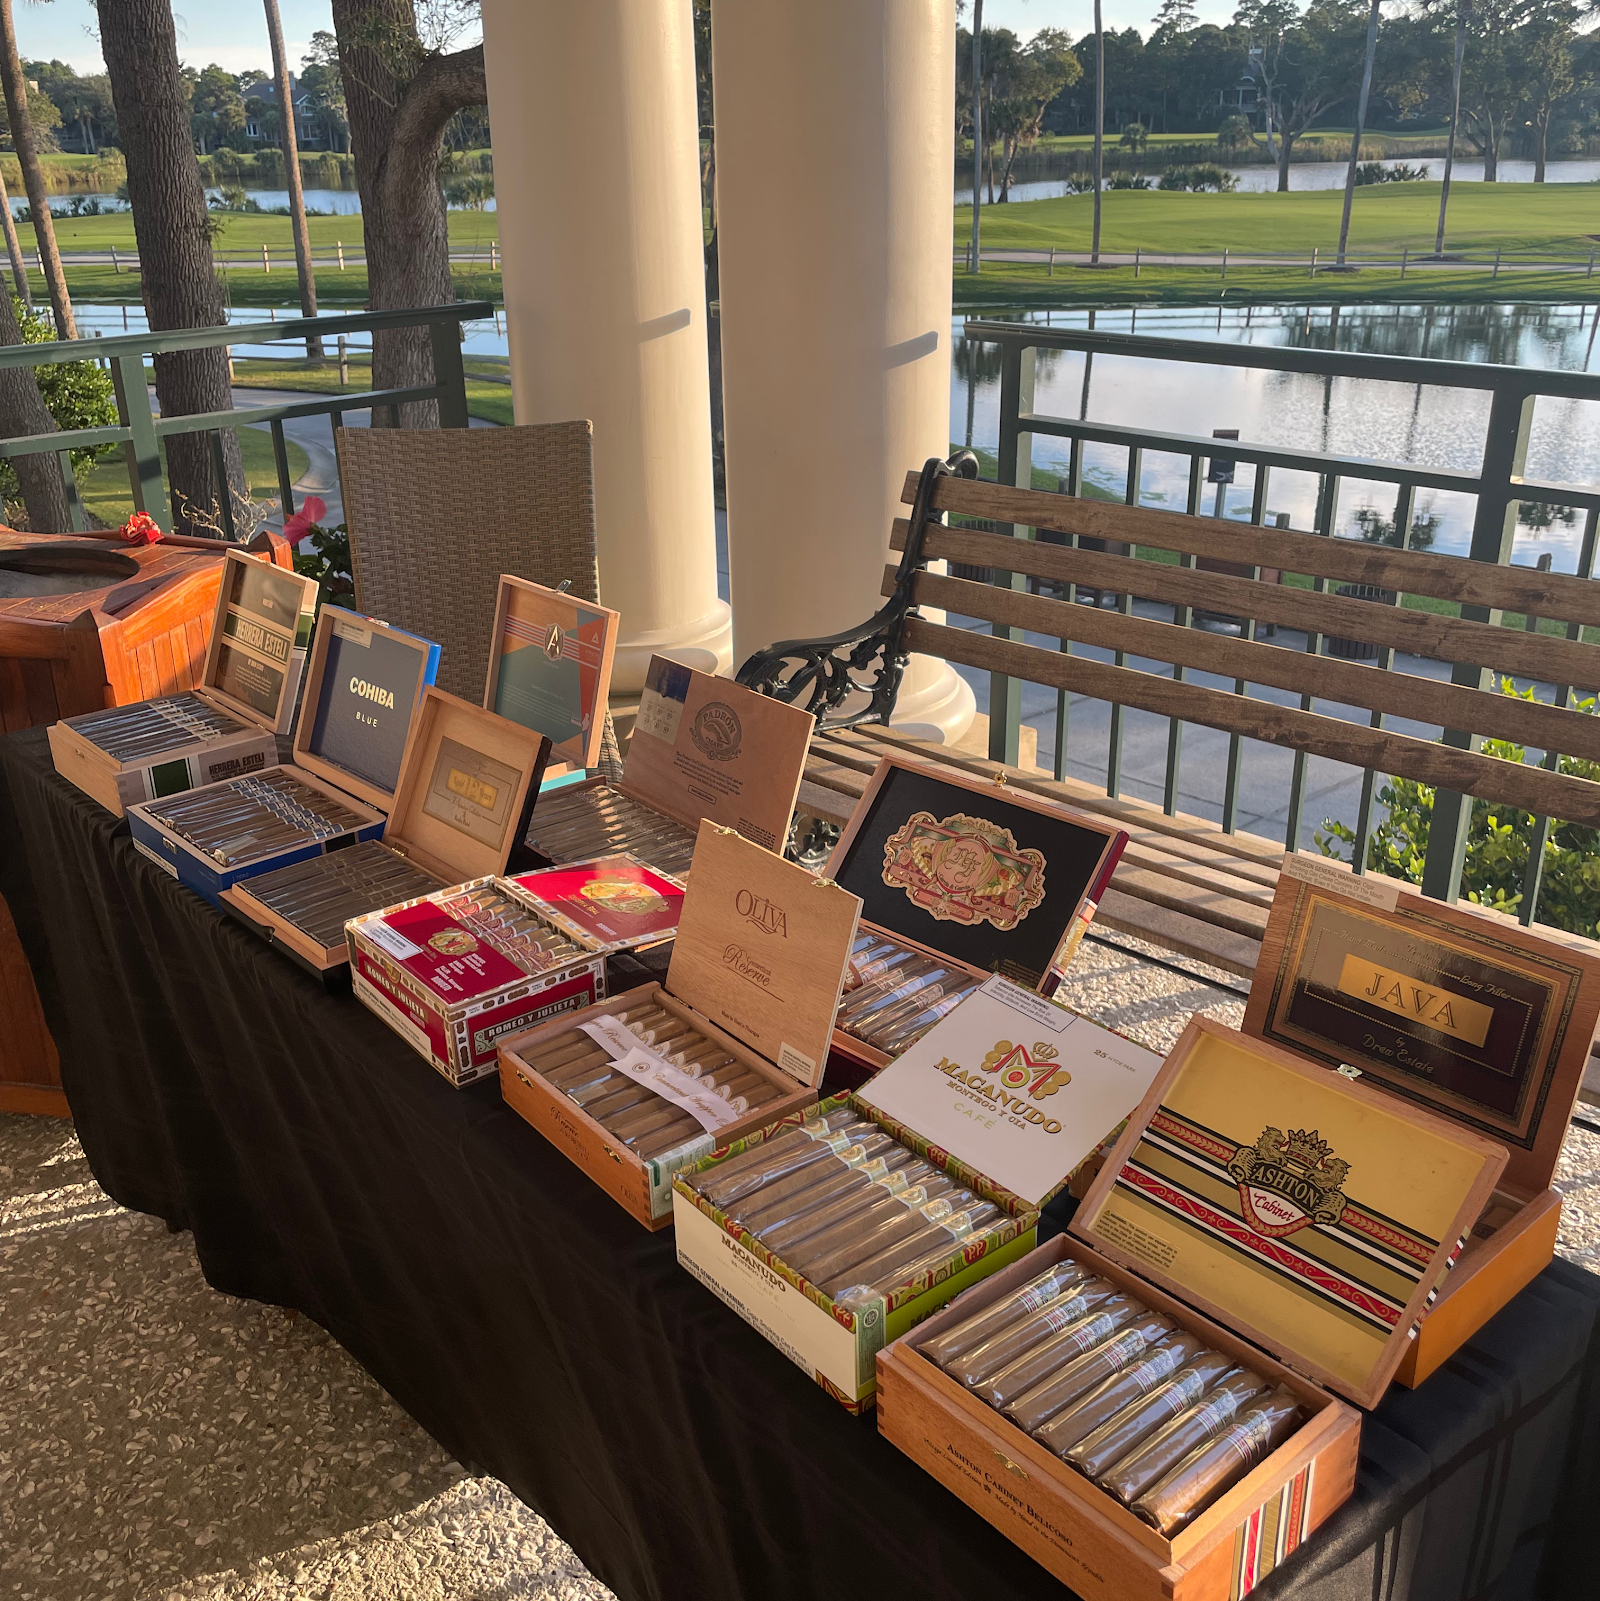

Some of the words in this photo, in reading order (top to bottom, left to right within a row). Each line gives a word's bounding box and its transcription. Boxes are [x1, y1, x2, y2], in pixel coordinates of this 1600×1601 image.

[236, 619, 264, 649] HERRERA
[350, 676, 394, 709] COHIBA
[355, 711, 378, 728] BLUE
[208, 757, 241, 776] HERRERA
[242, 752, 265, 769] ESTELI
[1291, 857, 1314, 870] SURGEON
[1314, 865, 1337, 878] GENERAL
[1337, 873, 1362, 886] WARNING:
[735, 889, 788, 939] OLIVA
[722, 943, 770, 987] Reserve
[1340, 929, 1363, 945] Hand
[1364, 937, 1387, 953] Made
[1459, 974, 1484, 992] Long
[1485, 983, 1511, 1000] Filler
[1407, 944, 1441, 964] Premium
[366, 964, 390, 992] ROMEO
[397, 990, 426, 1019] JULIETA
[1365, 972, 1458, 1030] JAVA
[488, 1018, 525, 1038] ROMEO
[527, 1013, 534, 1022] Y
[536, 998, 576, 1019] JULIETA
[1093, 1049, 1107, 1061] 25
[1106, 1056, 1123, 1069] HYDE
[1122, 1063, 1137, 1073] PARK
[1362, 1033, 1394, 1058] Drew
[1396, 1048, 1434, 1074] Estate
[1395, 1036, 1406, 1048] by
[933, 1056, 1062, 1134] MACANUDO
[946, 1079, 997, 1112] MONTEGO
[998, 1109, 1008, 1118] Y
[1008, 1115, 1027, 1131] CIA
[953, 1102, 997, 1130] CAFÉ
[1254, 1164, 1320, 1209] ASHTON
[1253, 1191, 1296, 1223] Cabinet
[678, 1248, 700, 1271] SURGEON
[700, 1266, 721, 1289] GENERAL
[720, 1233, 786, 1292] MACANUDO
[732, 1253, 759, 1277] MONTEGO
[943, 1453, 962, 1471] Limited
[947, 1444, 982, 1476] ASHTON
[984, 1472, 1024, 1508] CABINET
[1026, 1503, 1073, 1547] BELICOSO
[994, 1493, 1010, 1509] Made
[1009, 1506, 1017, 1515] by
[1017, 1512, 1034, 1527] Hand
[1040, 1530, 1049, 1539] the
[1049, 1537, 1080, 1564] Dominican
[1080, 1562, 1105, 1584] Republic
